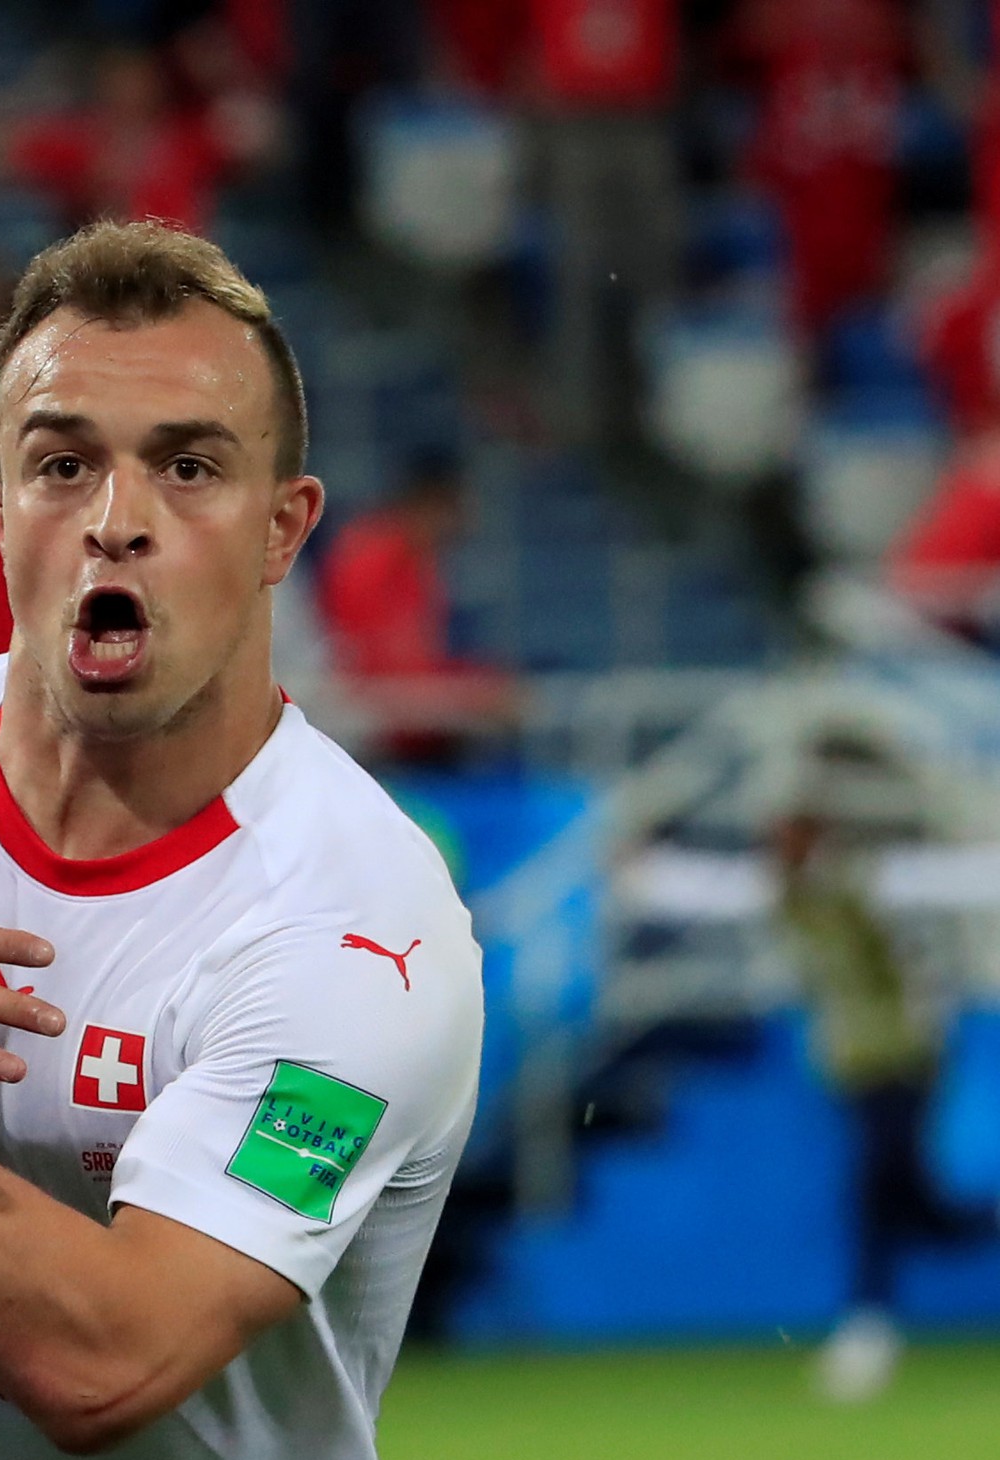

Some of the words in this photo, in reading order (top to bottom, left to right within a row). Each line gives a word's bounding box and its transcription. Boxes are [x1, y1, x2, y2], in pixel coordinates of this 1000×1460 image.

[268, 1098, 364, 1149] LIVING
[82, 1151, 115, 1171] SRB
[309, 1163, 338, 1190] FIFA
